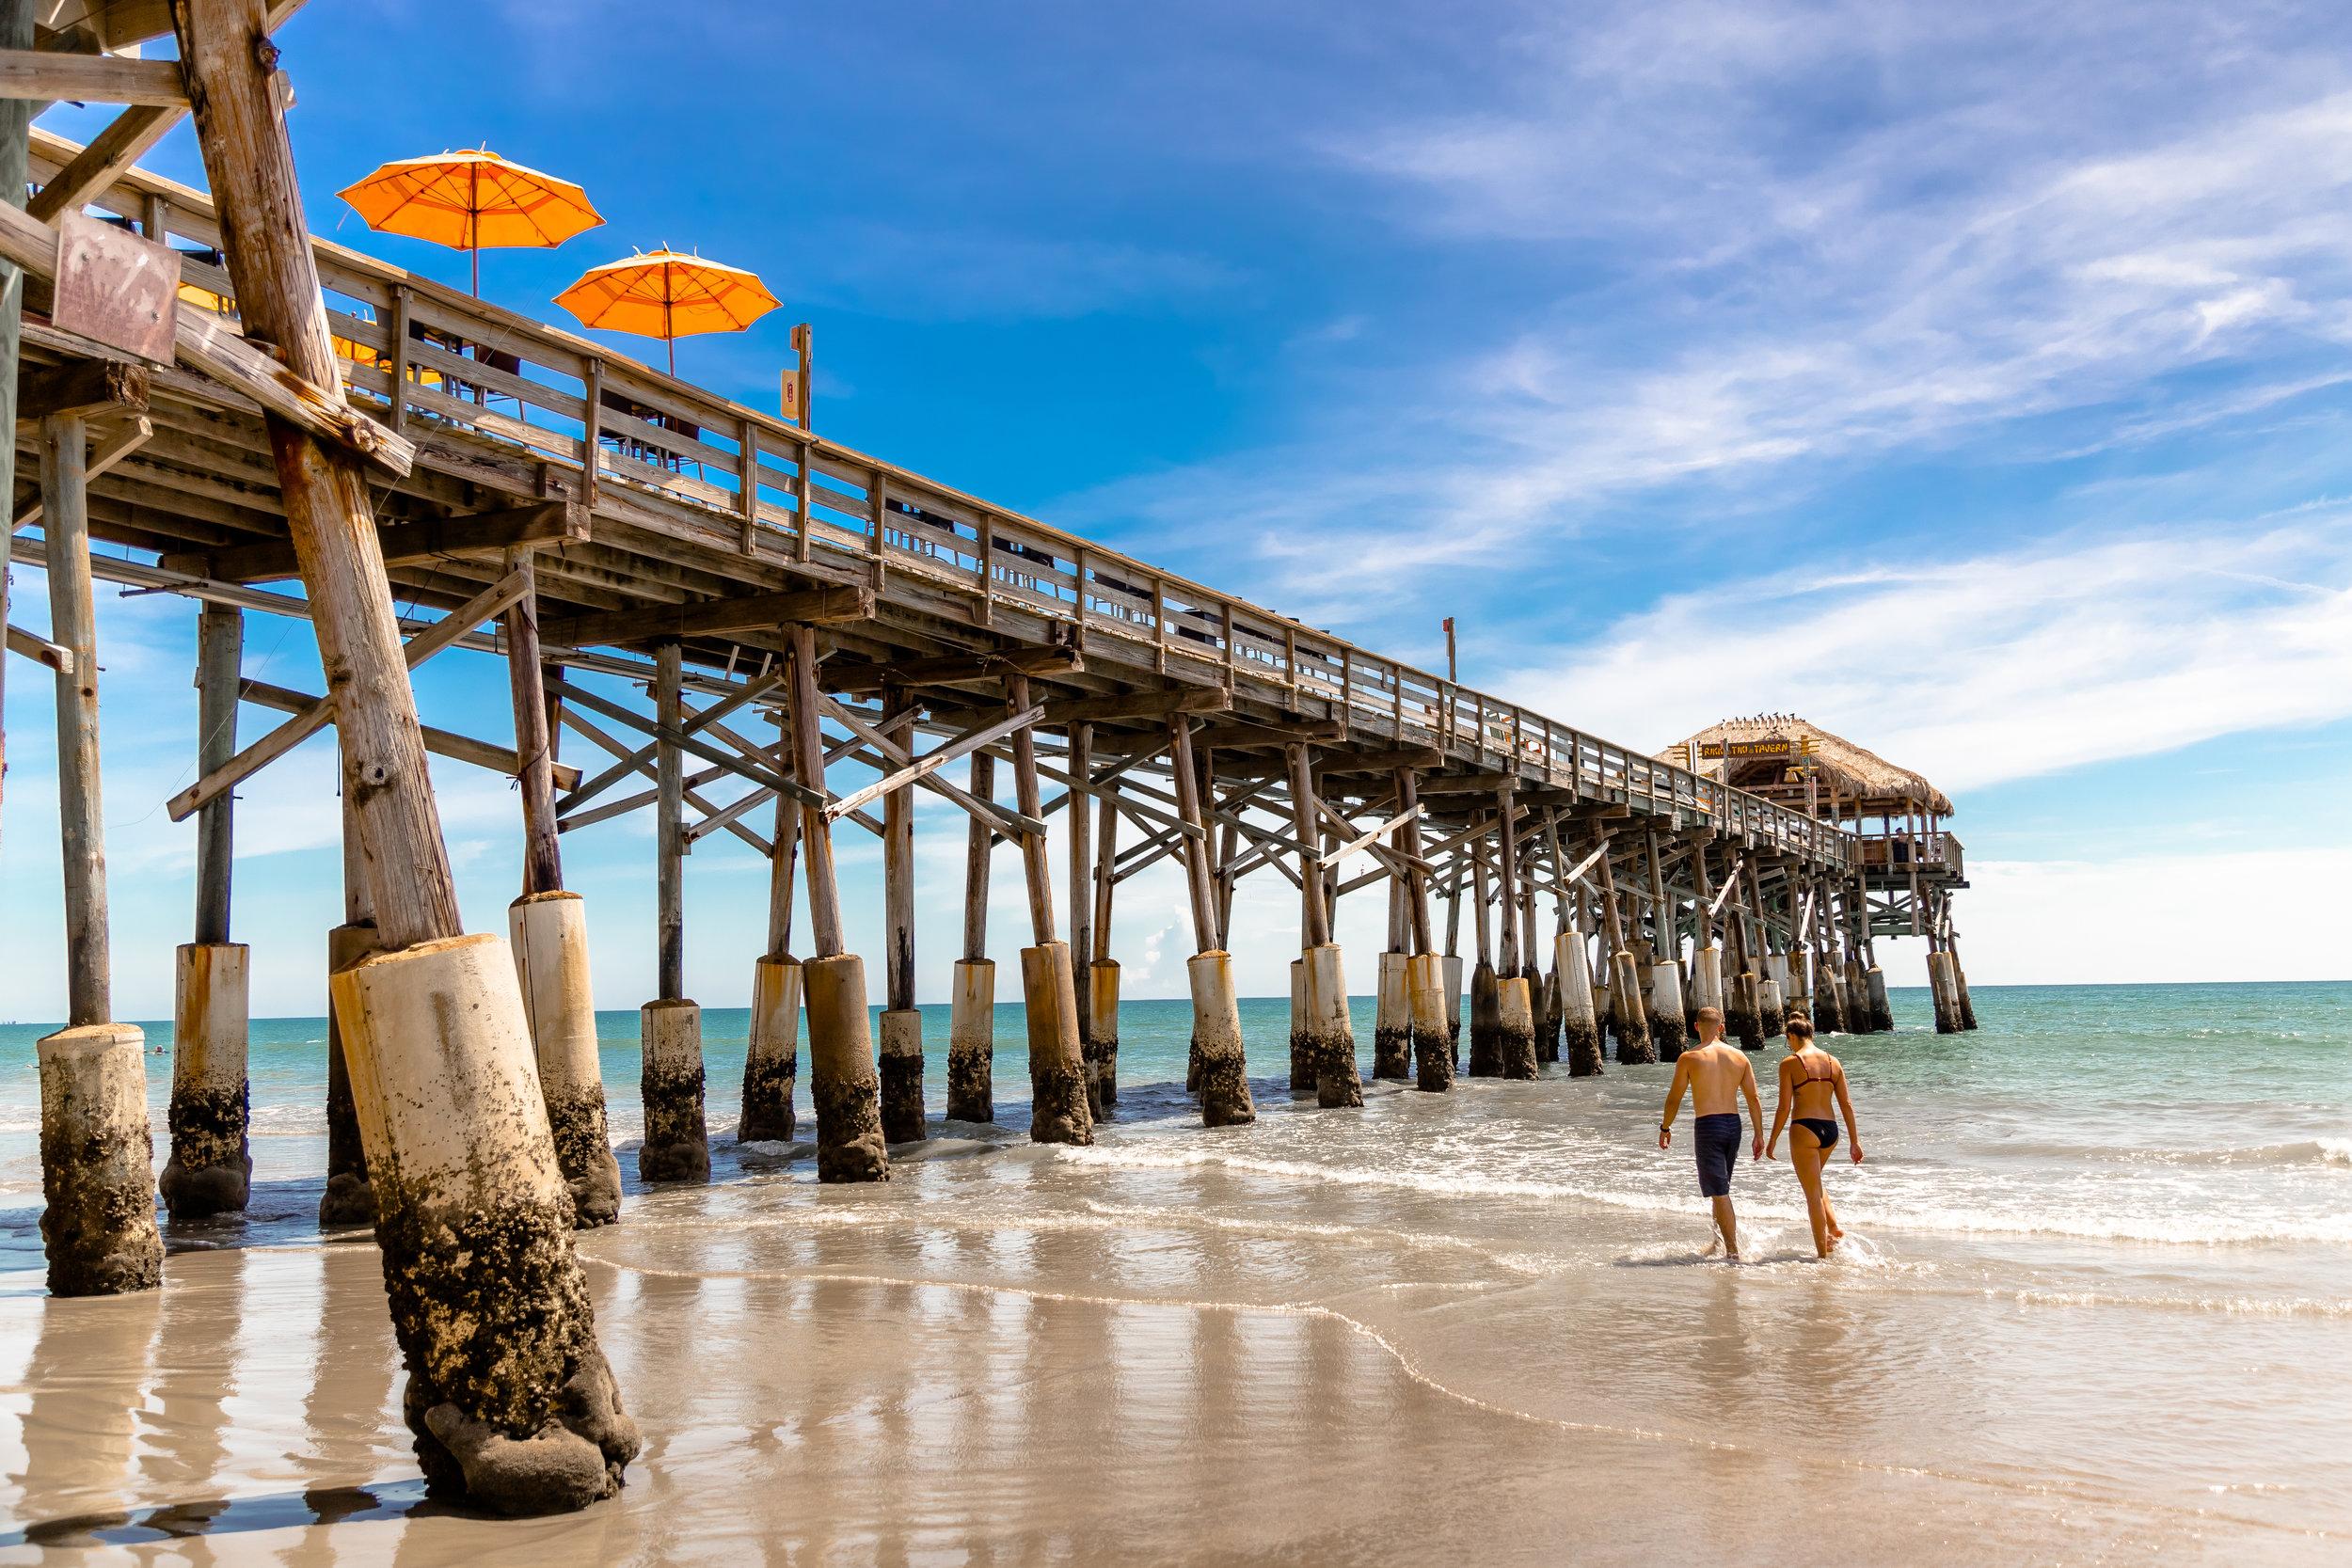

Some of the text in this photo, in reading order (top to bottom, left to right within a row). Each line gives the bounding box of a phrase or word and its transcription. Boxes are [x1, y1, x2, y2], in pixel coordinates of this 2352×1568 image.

[1704, 743, 1788, 756] RIKK TIKI TAVERN
